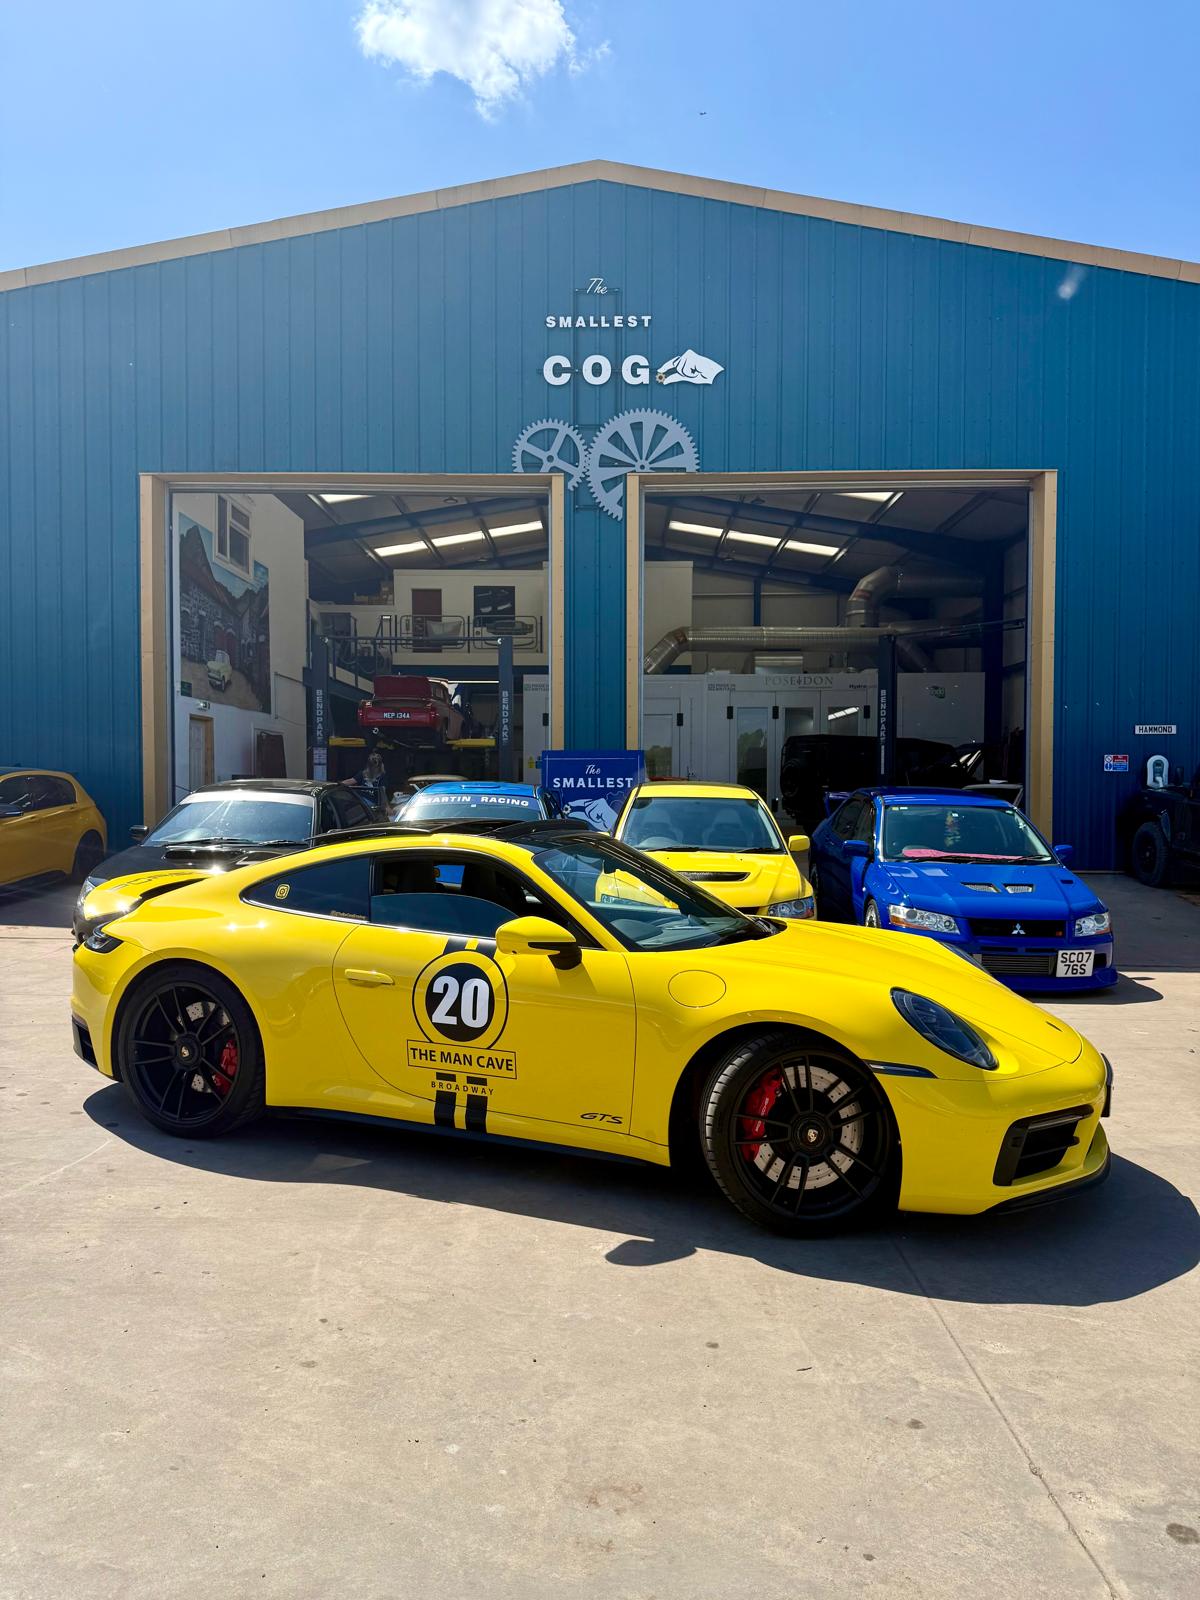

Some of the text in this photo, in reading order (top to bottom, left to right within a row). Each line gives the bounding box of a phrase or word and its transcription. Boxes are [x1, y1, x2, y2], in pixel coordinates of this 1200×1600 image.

[586, 277, 608, 295] The
[545, 315, 652, 328] SMALLEST
[543, 354, 650, 386] COG
[585, 764, 601, 775] The
[553, 777, 634, 788] SMALLEST
[480, 796, 529, 806] RACING
[1060, 952, 1092, 963] SC07
[1064, 964, 1087, 975] 76S
[431, 975, 490, 1028] 20
[410, 1047, 514, 1072] THE MAN CAVE
[431, 1080, 495, 1096] BROADWAY
[580, 1112, 624, 1125] GTS
